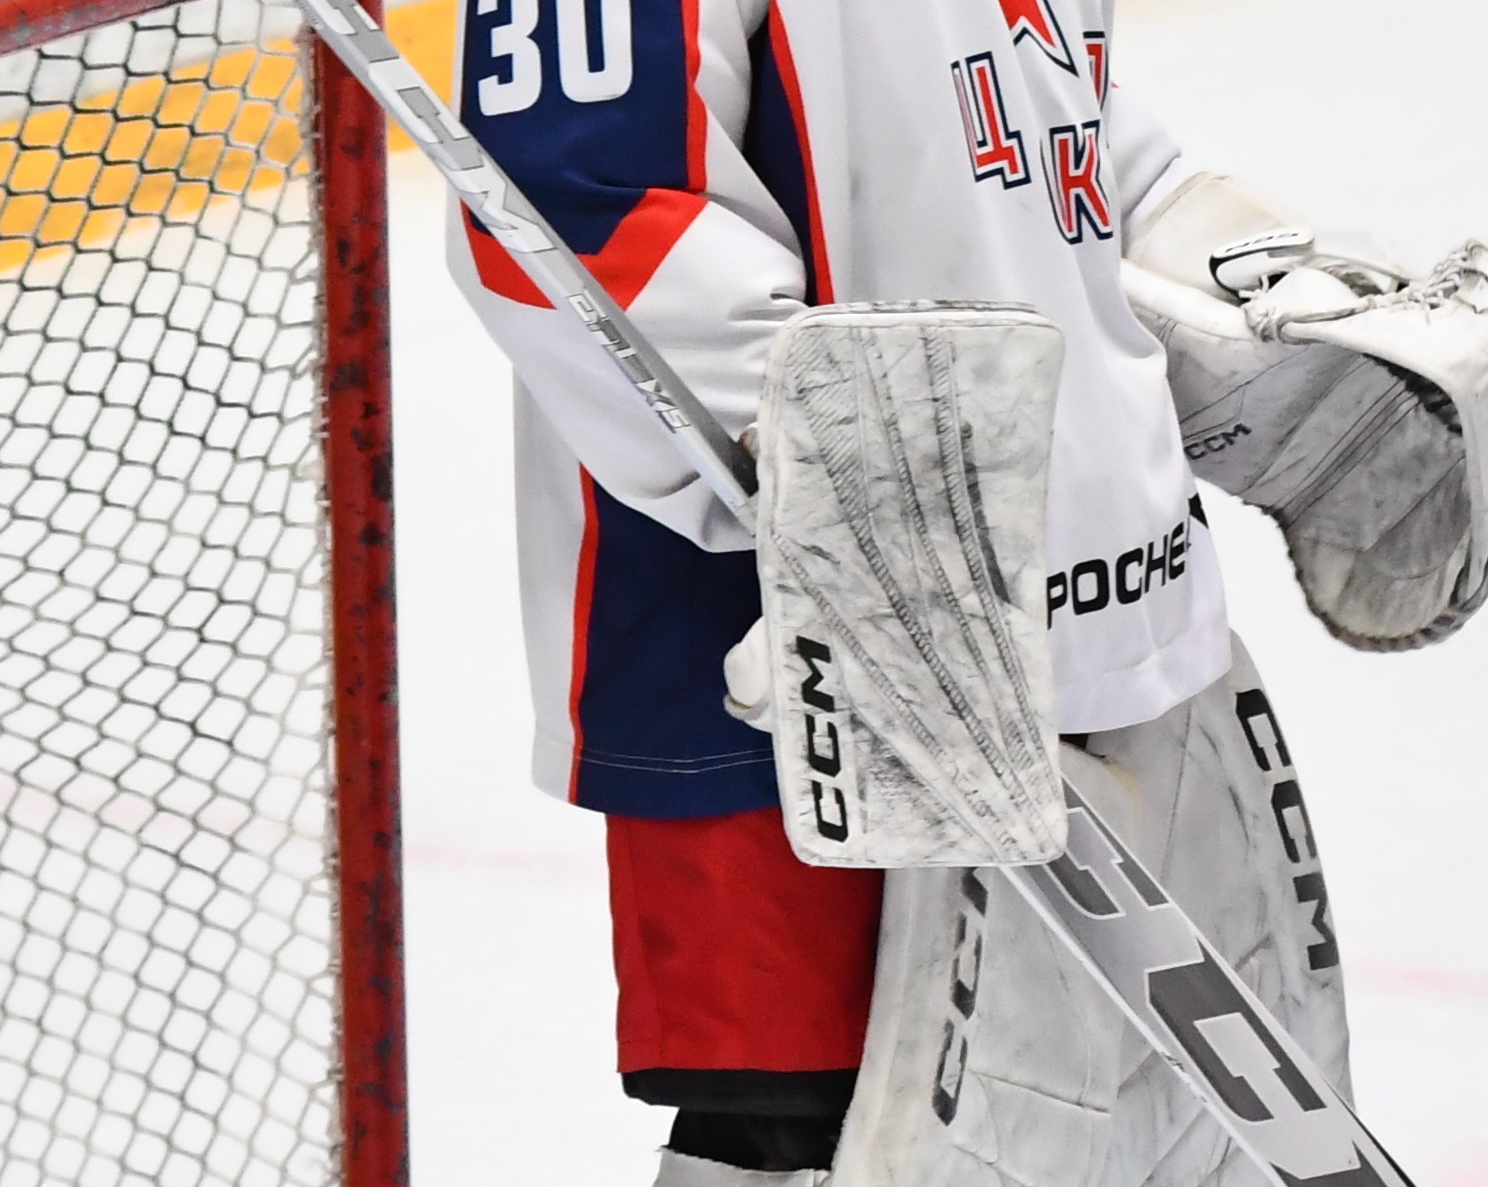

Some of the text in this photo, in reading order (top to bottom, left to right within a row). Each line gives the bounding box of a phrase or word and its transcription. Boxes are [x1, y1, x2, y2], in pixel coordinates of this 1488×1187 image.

[1184, 423, 1251, 461] CCM
[1046, 515, 1192, 630] РОСНЕ
[796, 635, 851, 844] CCM
[1236, 688, 1340, 971] CCM
[1042, 778, 1390, 1187] CC
